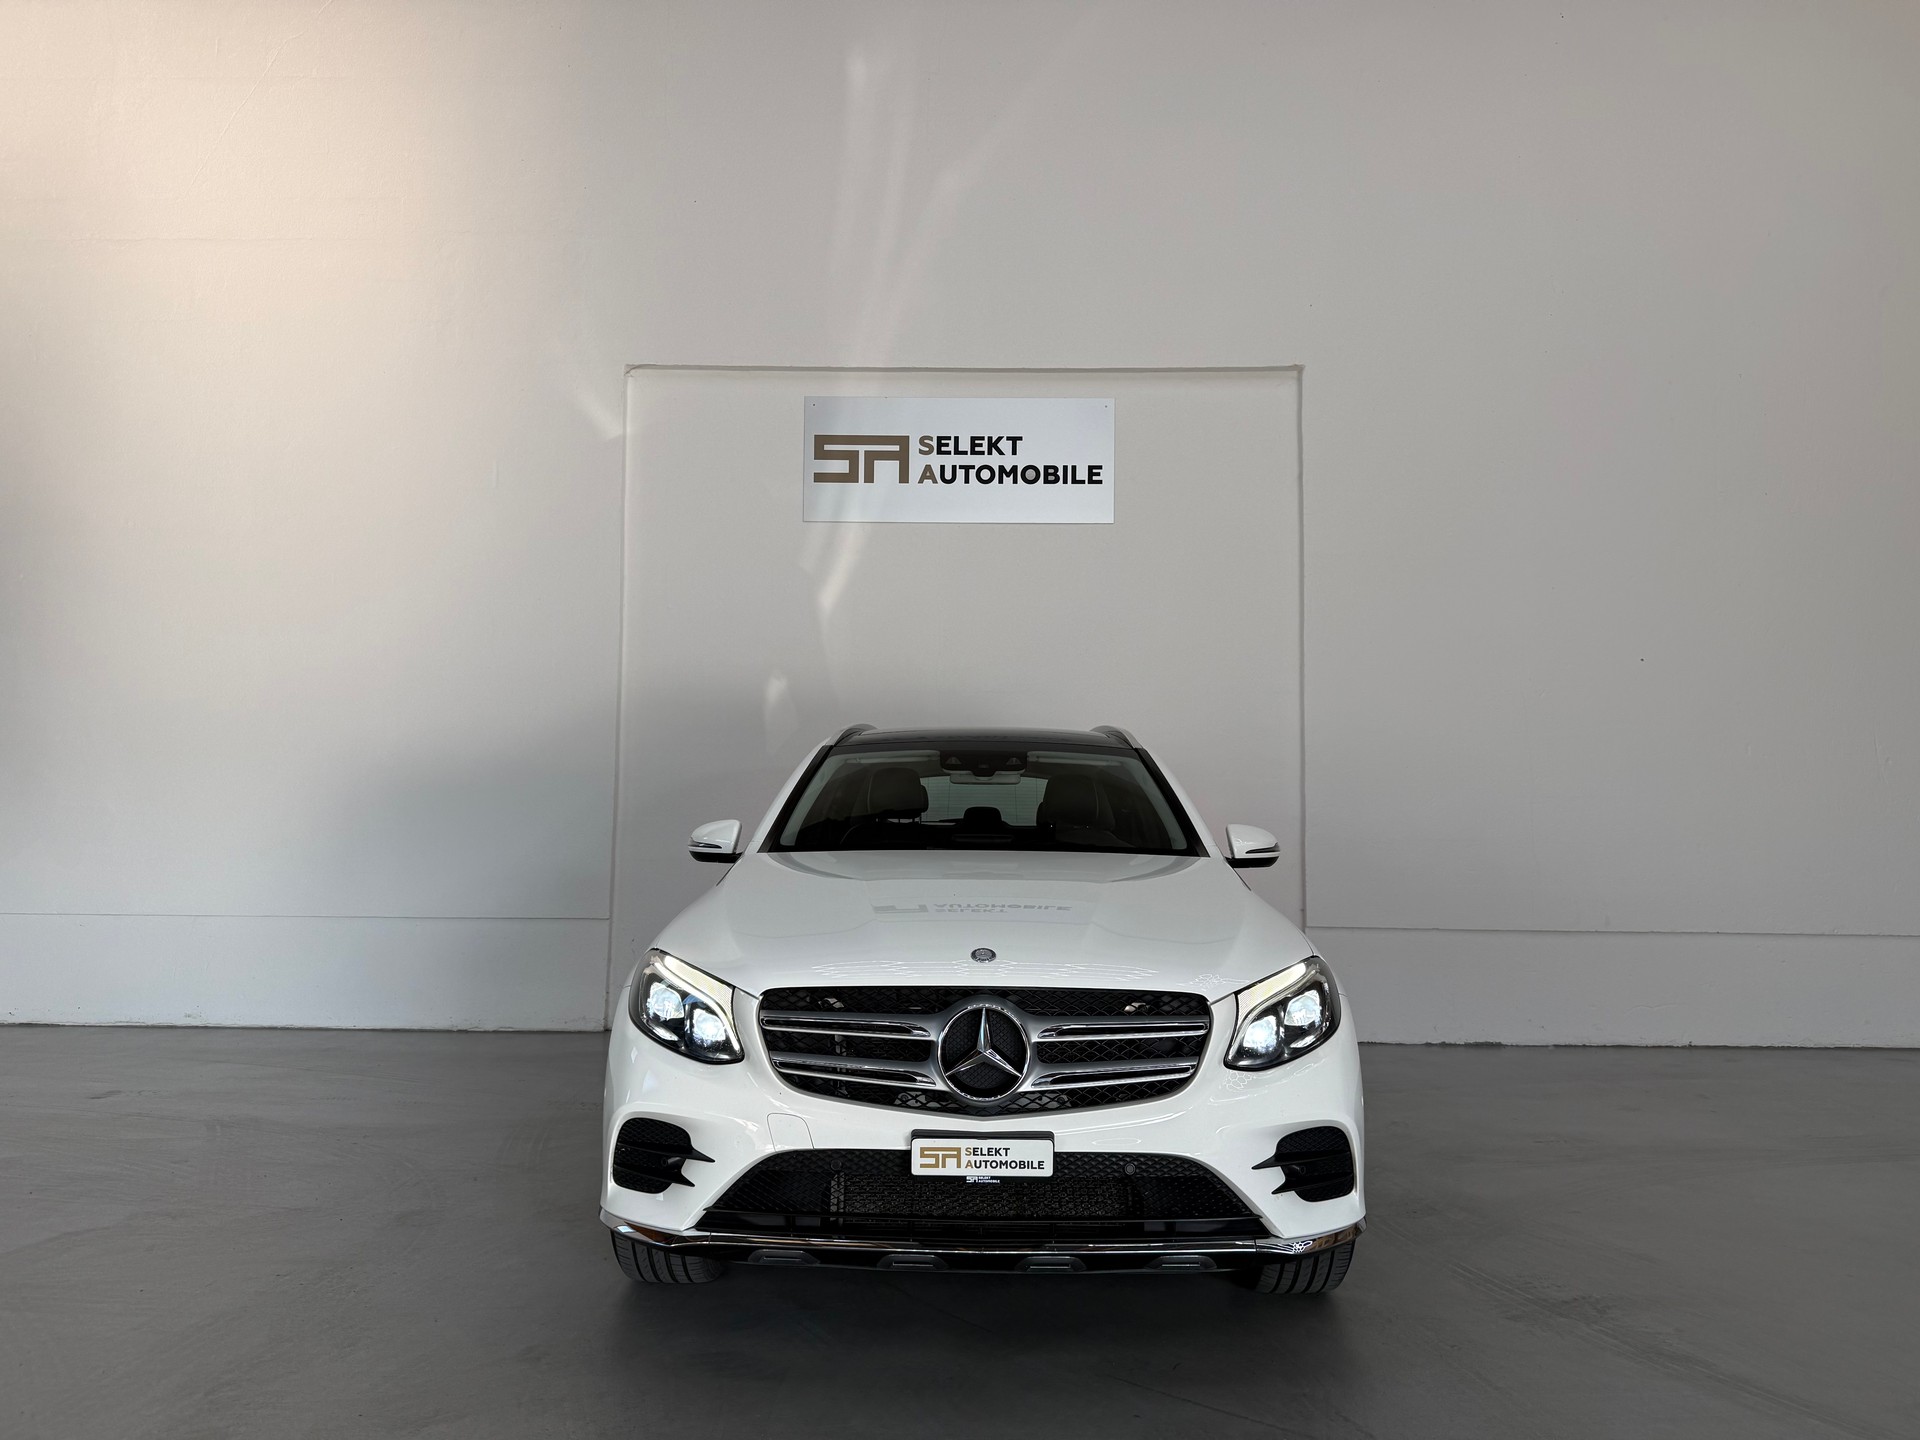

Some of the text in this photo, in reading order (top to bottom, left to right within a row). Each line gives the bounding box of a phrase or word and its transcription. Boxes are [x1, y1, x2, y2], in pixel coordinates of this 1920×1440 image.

[917, 435, 1023, 456] SELEKT
[917, 464, 1103, 485] AUTOMOBILE
[965, 1147, 1010, 1156] SELEKT
[965, 1160, 1045, 1169] AUTOMOBILE
